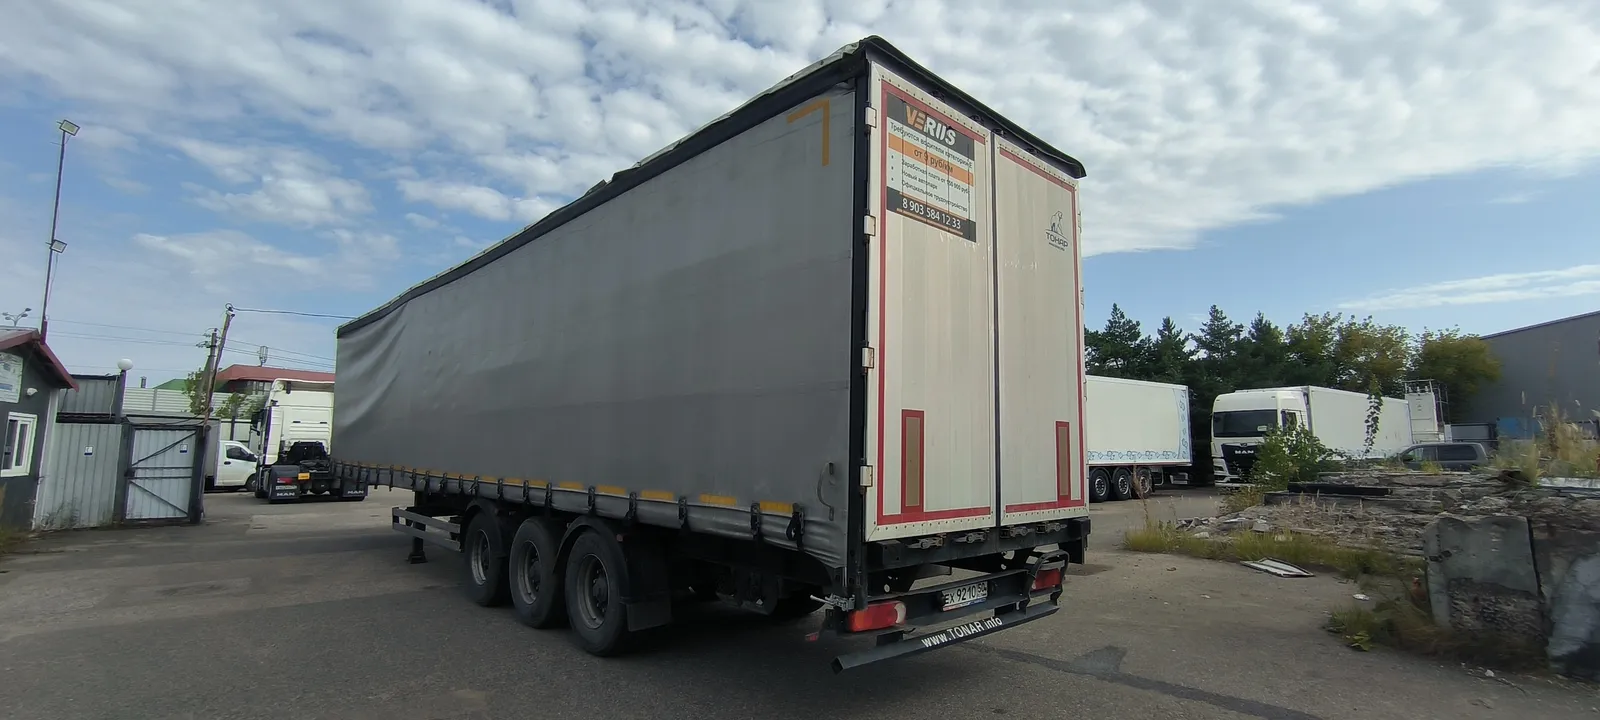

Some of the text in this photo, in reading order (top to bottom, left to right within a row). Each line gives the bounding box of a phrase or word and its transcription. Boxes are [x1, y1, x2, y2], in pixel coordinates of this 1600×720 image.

[890, 121, 920, 143] Требуются
[920, 139, 944, 154] водители
[914, 149, 922, 158] от
[930, 156, 953, 172] руб/км
[902, 198, 961, 229] 8 903 584 12 33
[957, 585, 977, 602] 9210
[921, 616, 1003, 648] www.TONARinfo
